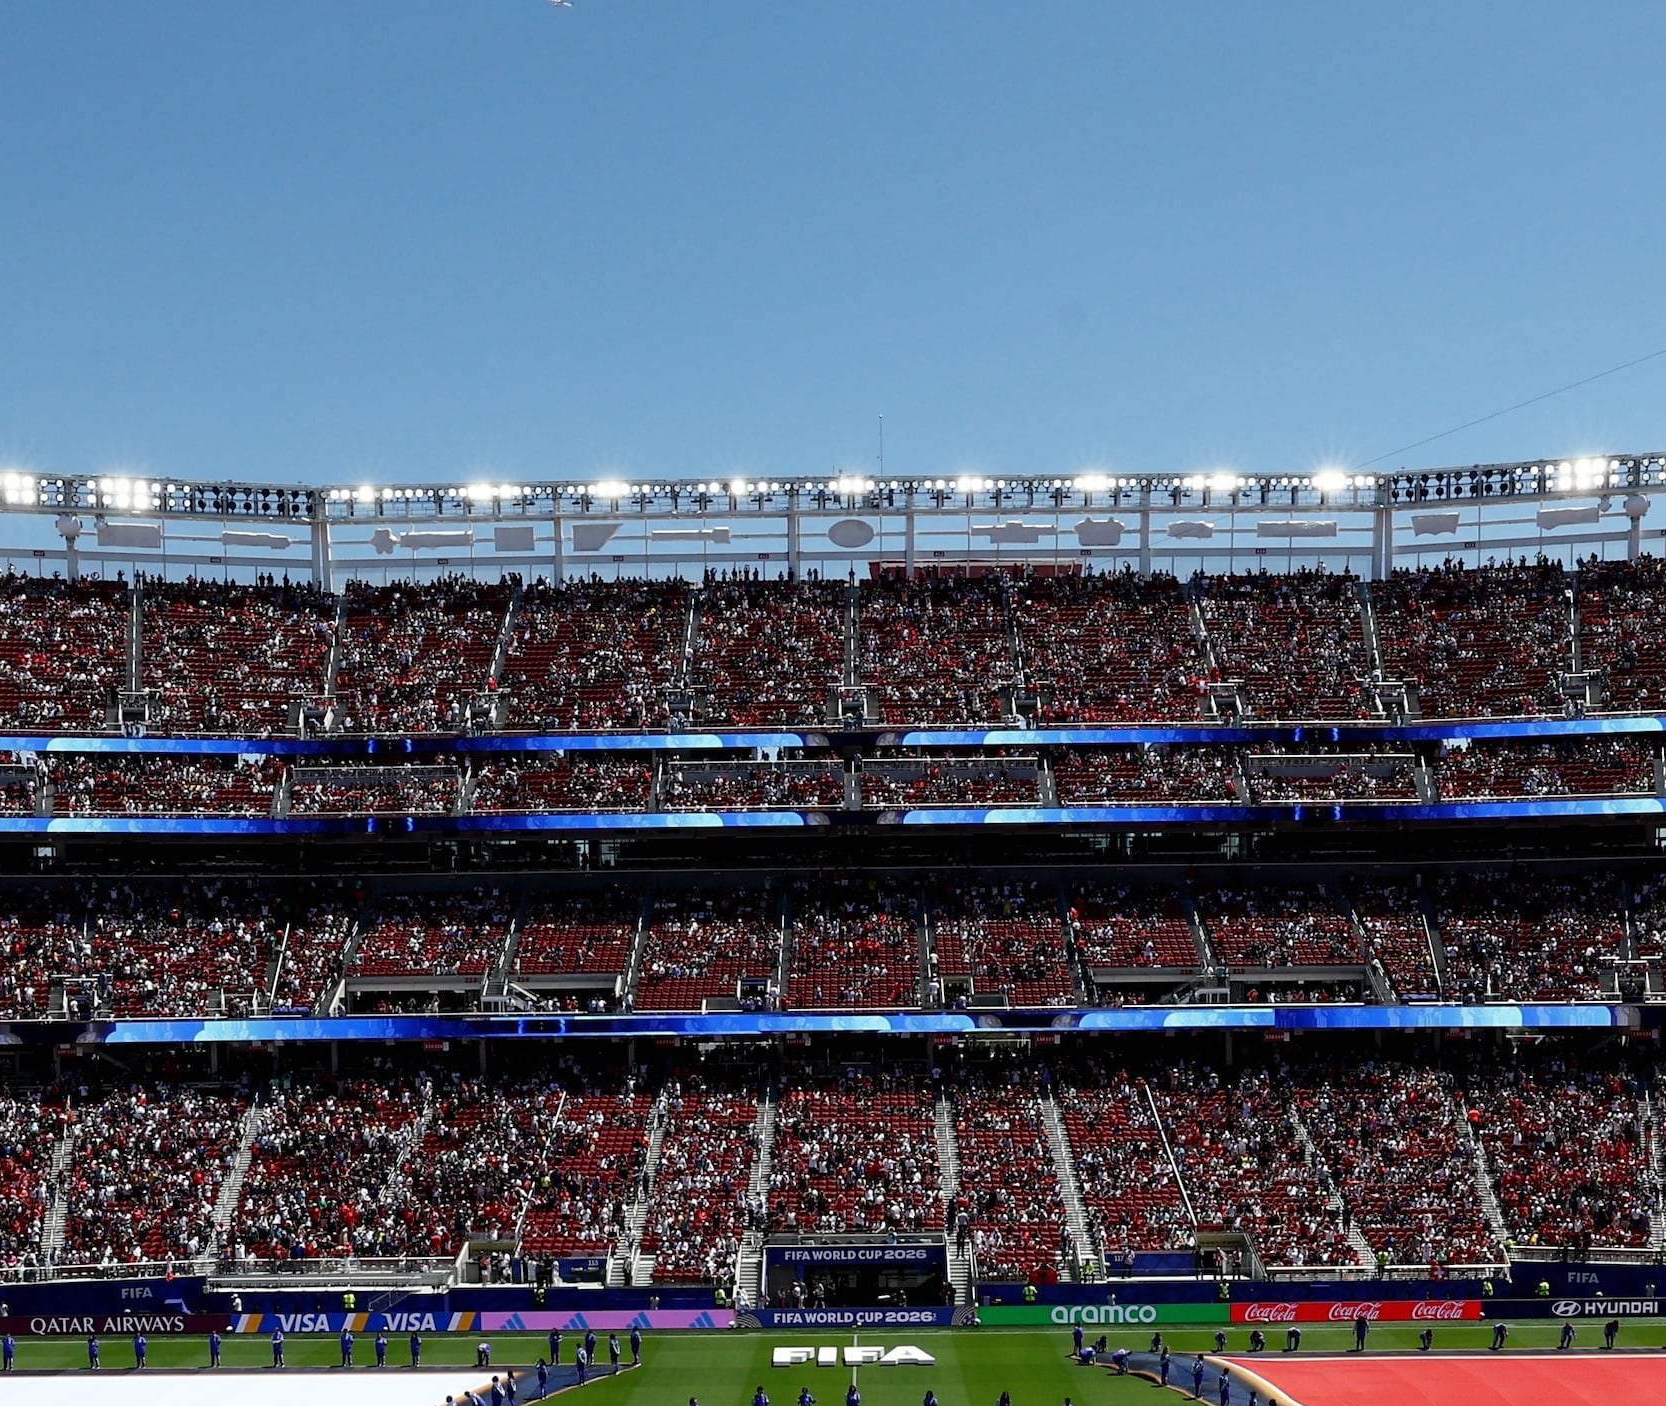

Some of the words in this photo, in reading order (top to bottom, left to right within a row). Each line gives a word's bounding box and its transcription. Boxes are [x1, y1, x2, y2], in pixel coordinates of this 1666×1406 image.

[785, 1250, 811, 1261] FIFA
[813, 1250, 857, 1261] WORLD
[858, 1250, 883, 1260] CUP
[883, 1249, 927, 1260] 2026
[1567, 1271, 1600, 1284] FIFA
[121, 1287, 153, 1300] FIFA
[1050, 1304, 1157, 1323] aramco
[1244, 1303, 1298, 1322] Coca-Cola
[1329, 1302, 1382, 1321] Coca-Cola
[1412, 1301, 1466, 1320] Coca-Cola
[1584, 1300, 1659, 1314] HYUNDAI
[30, 1317, 95, 1336] QATAR
[103, 1315, 184, 1332] AIRWAYS
[278, 1313, 331, 1332] VISA
[383, 1312, 436, 1331] VISA
[773, 1312, 803, 1324] FIFA
[804, 1312, 855, 1323] WORLD
[856, 1312, 883, 1323] CUP
[885, 1311, 933, 1322] 2026
[771, 1345, 935, 1367] FIFA
